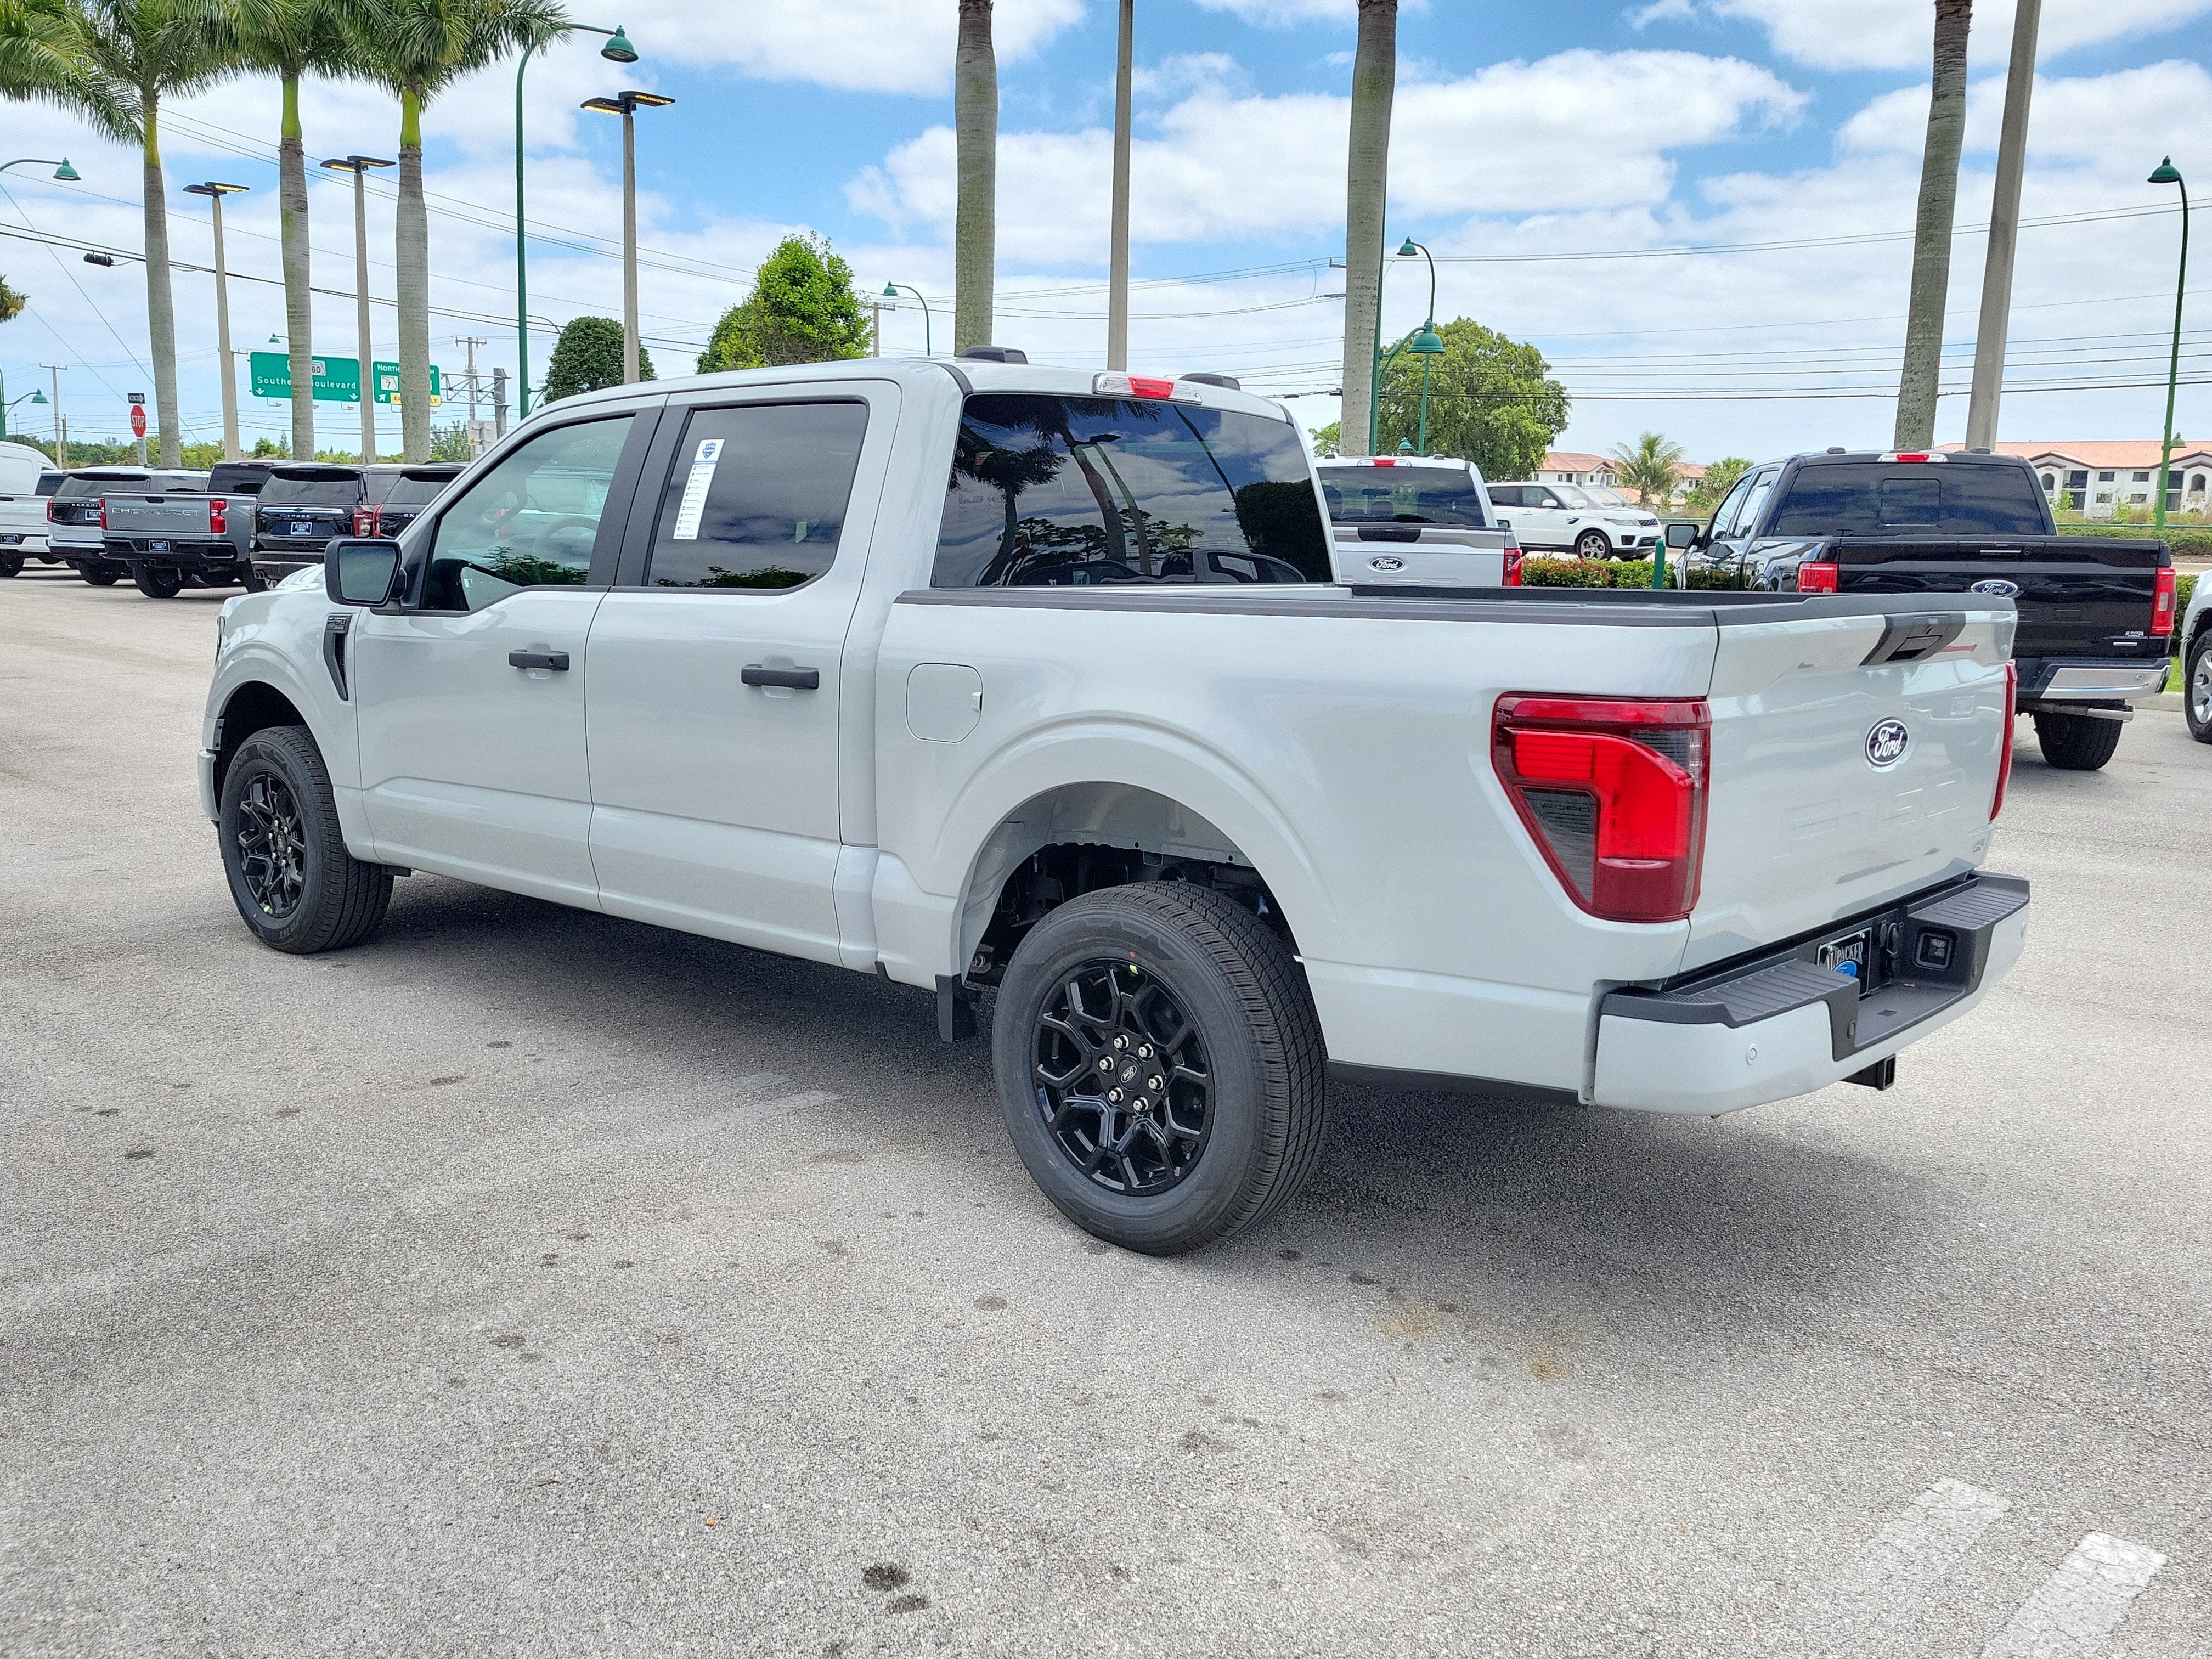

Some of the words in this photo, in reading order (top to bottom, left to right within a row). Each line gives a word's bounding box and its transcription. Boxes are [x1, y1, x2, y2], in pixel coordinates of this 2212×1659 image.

[377, 364, 400, 373] NORTH
[257, 376, 291, 385] Southe
[312, 379, 357, 389] oulevard
[385, 381, 391, 389] 7
[132, 415, 145, 427] STOP
[111, 507, 199, 516] CHEVROLET
[1376, 558, 1399, 569] Ford
[1982, 583, 2008, 594] Ford
[1874, 726, 1903, 758] Ford
[1542, 803, 1590, 812] FORD
[1836, 941, 1863, 966] PACKER
